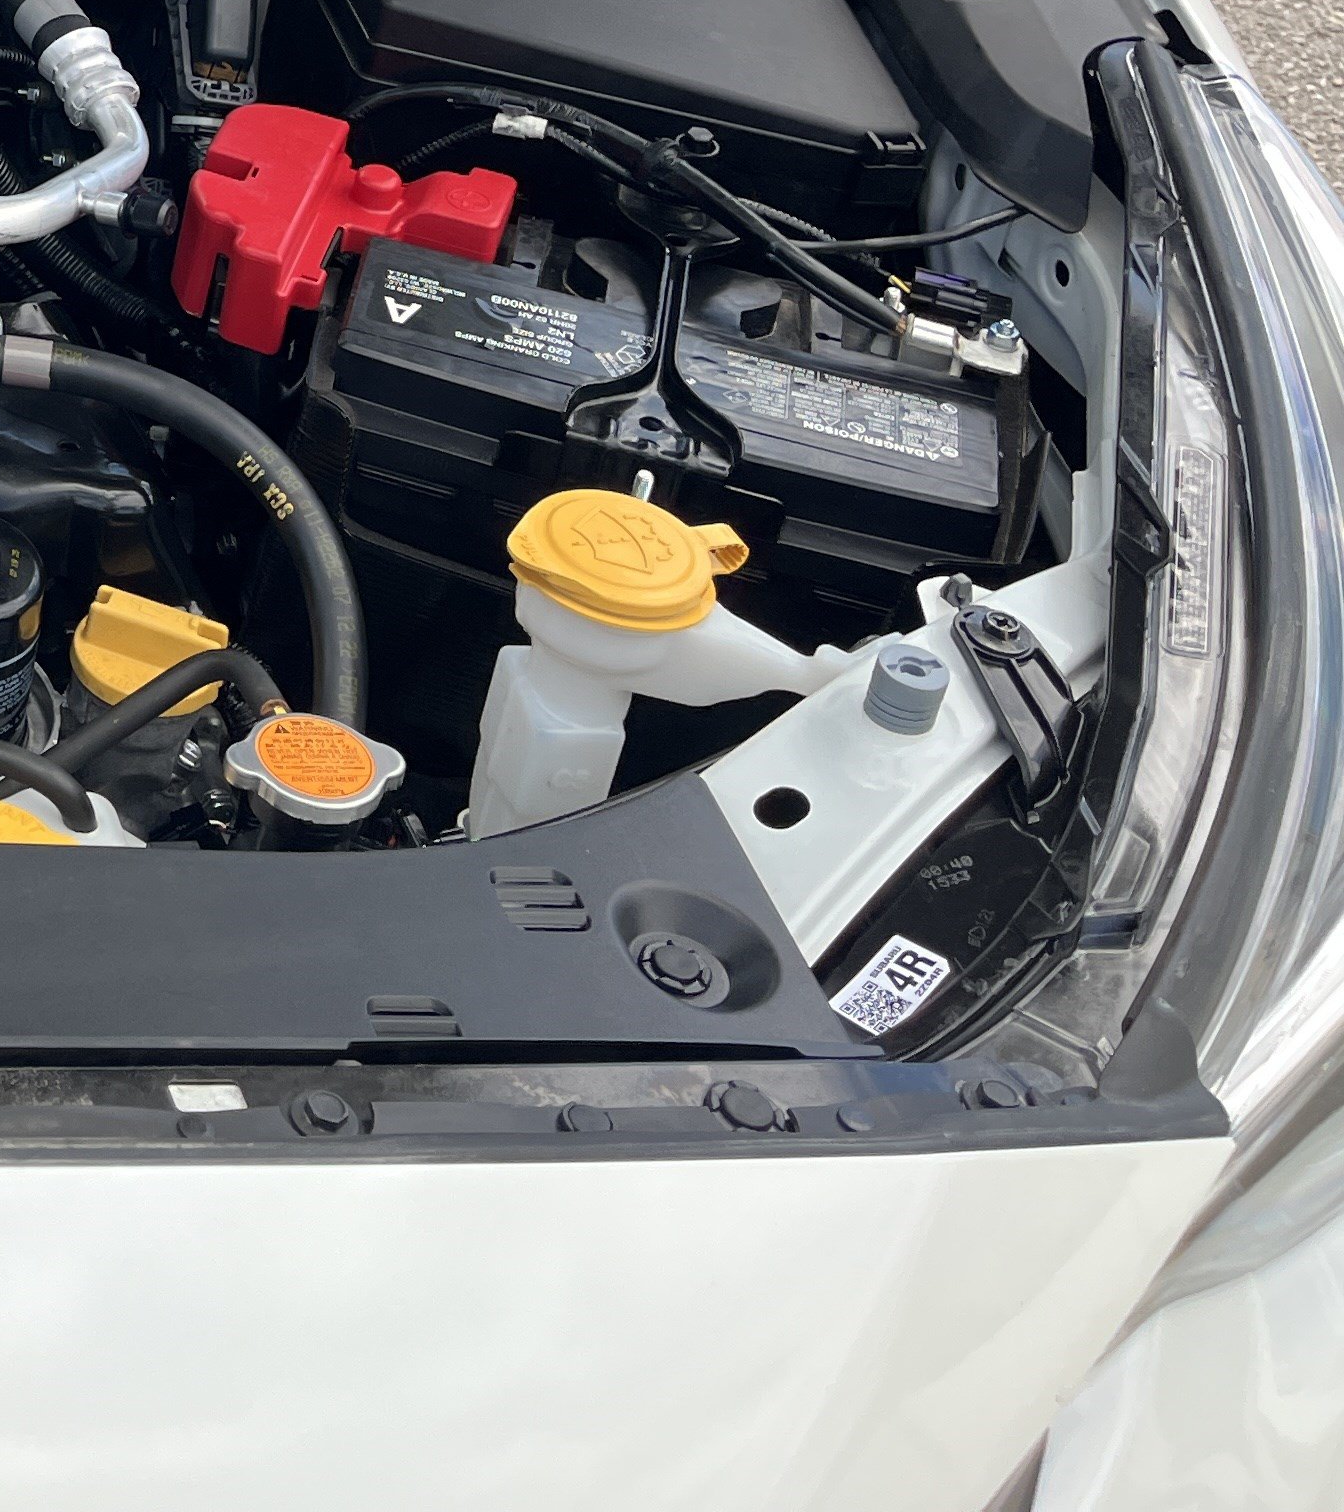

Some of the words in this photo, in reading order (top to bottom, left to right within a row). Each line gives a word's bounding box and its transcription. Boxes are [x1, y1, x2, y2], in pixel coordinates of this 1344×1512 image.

[454, 330, 484, 343] AMPS
[511, 326, 534, 338] SIZE
[547, 326, 574, 339] LN2
[485, 338, 540, 357] CRANKING
[503, 334, 545, 350] AMPS
[536, 333, 574, 348] GROUP
[541, 352, 571, 365] COLD
[547, 345, 572, 357] 620
[802, 420, 926, 458] DANGER/POISON
[870, 946, 902, 978] SUBARU
[885, 948, 937, 992] 4R
